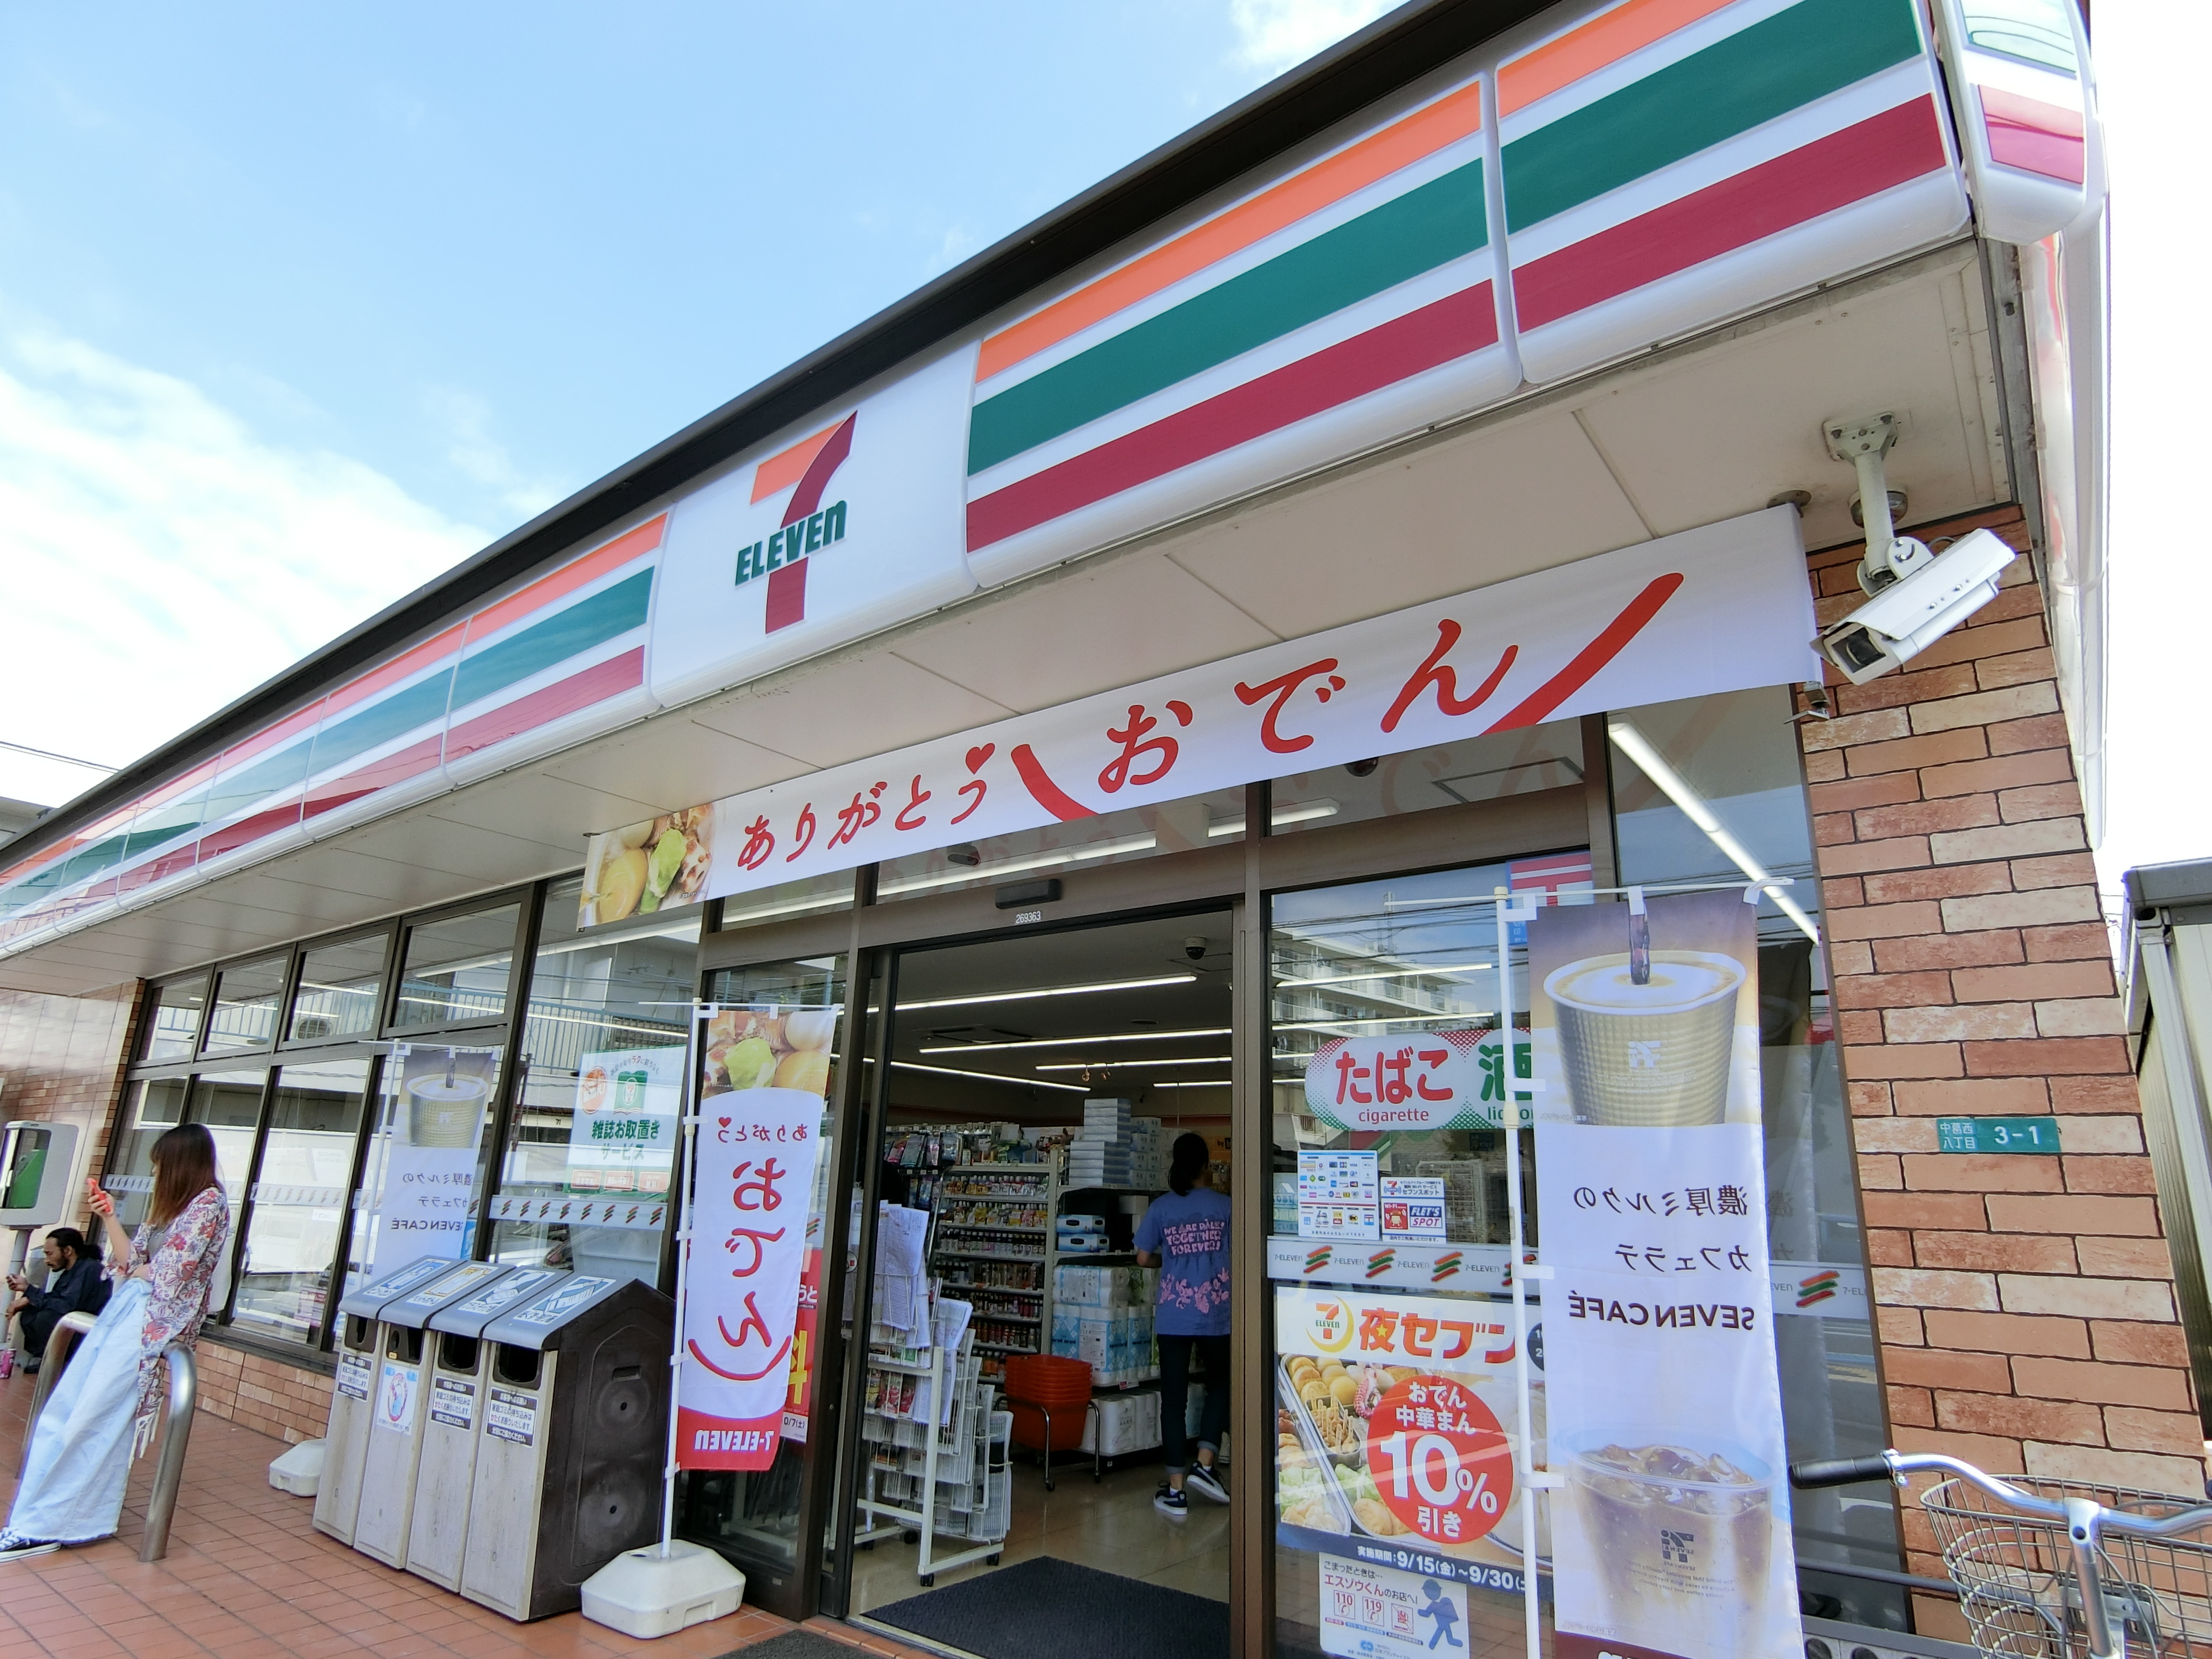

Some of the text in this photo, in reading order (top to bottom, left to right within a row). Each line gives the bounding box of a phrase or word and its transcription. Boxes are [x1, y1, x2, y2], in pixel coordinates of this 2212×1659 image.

[1097, 618, 1519, 795] おでん
[738, 743, 995, 872] ありがとう
[1016, 911, 1041, 924] 269363
[1335, 1046, 1453, 1104] たばこ
[1358, 1108, 1430, 1124] cigarette
[591, 1119, 660, 1140] 雑誌お取置き
[1939, 1121, 1974, 1135] 中葛西
[1994, 1125, 2039, 1144] 3-1
[602, 1142, 644, 1161] サービス
[1943, 1136, 1976, 1149] 八丁目
[1411, 1207, 1441, 1217] FLET'S
[1164, 1226, 1178, 1235] WE
[1412, 1218, 1439, 1227] SPOT
[1166, 1229, 1222, 1245] TOGETHER
[1171, 1240, 1221, 1256] FOREVER!
[1359, 1307, 1516, 1364] 夜セブン
[1408, 1381, 1467, 1408] おでん
[1396, 1404, 1476, 1435] 中華まん
[1380, 1431, 1498, 1514] 10%
[1417, 1505, 1463, 1537] 引き
[1335, 1592, 1382, 1612] 110 119
